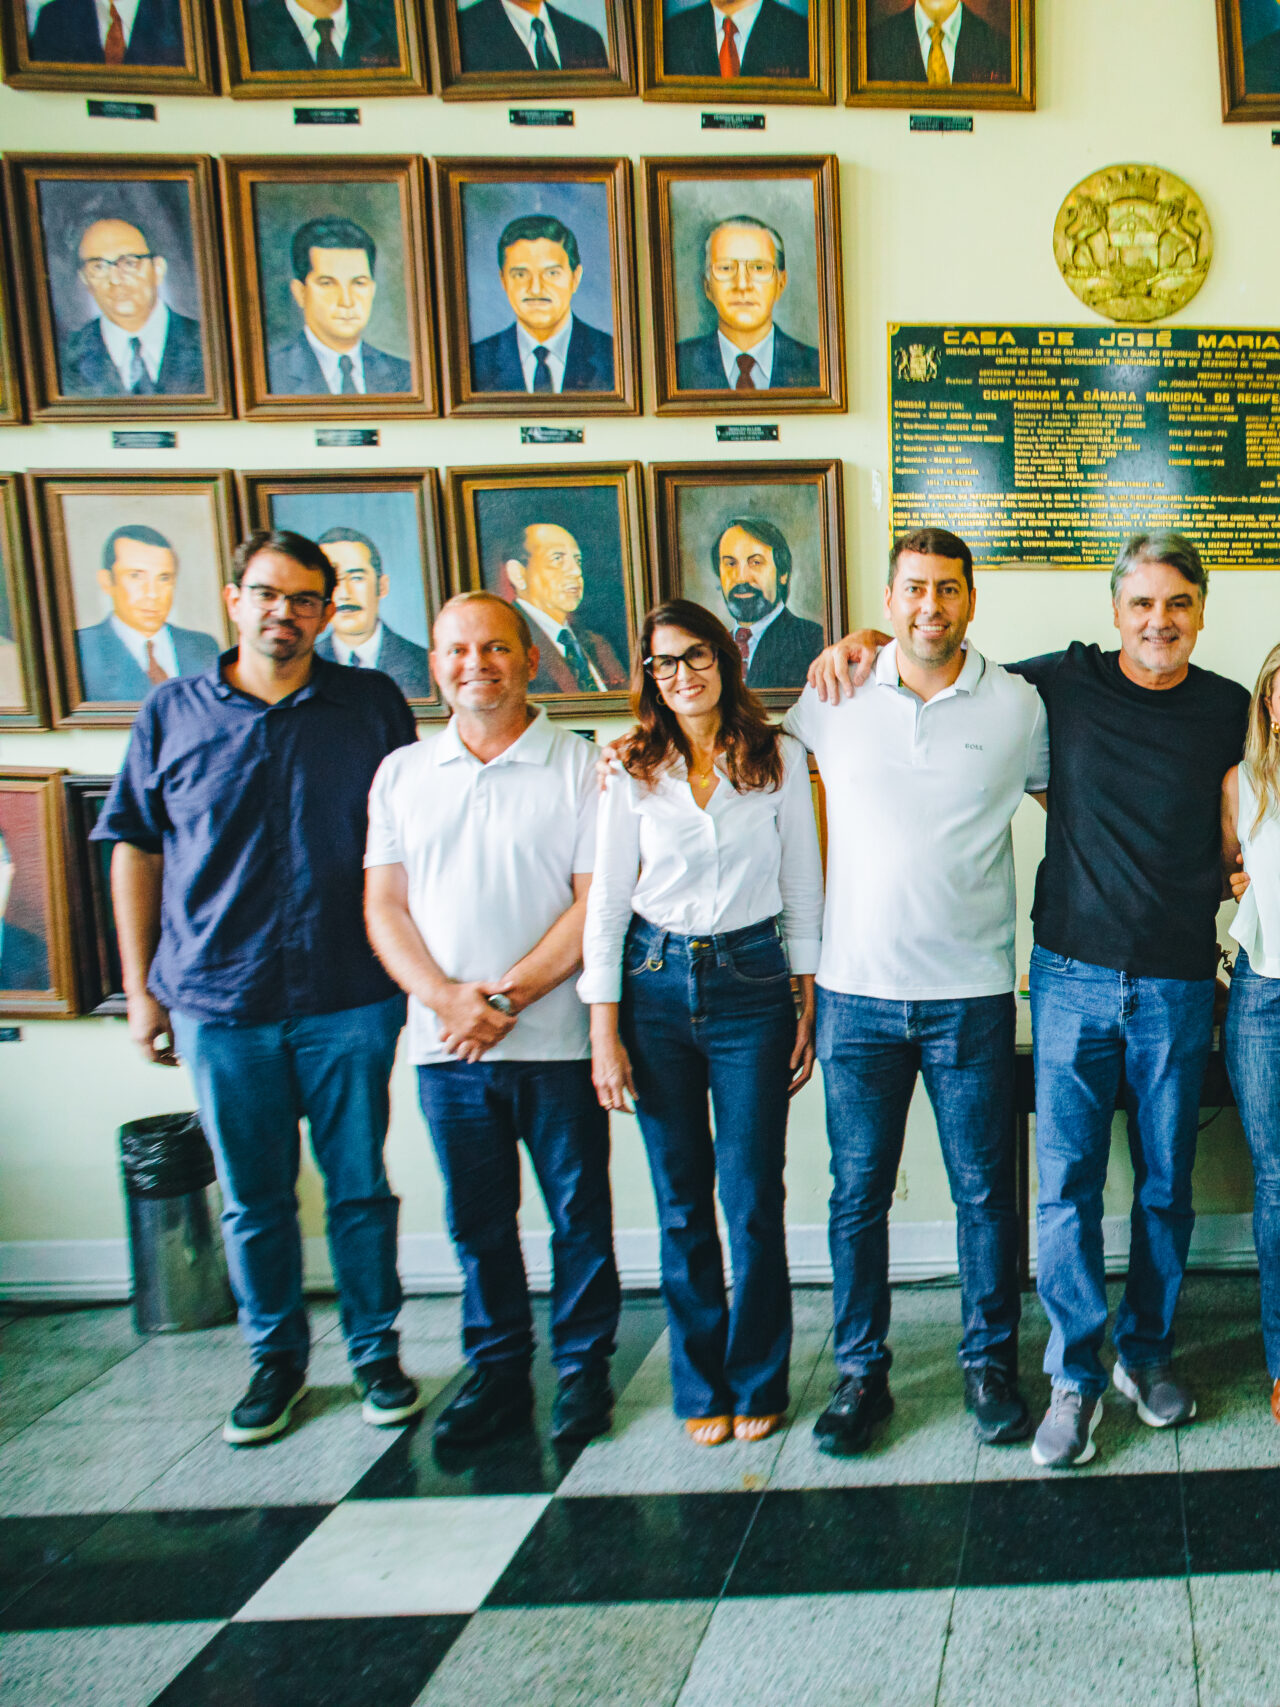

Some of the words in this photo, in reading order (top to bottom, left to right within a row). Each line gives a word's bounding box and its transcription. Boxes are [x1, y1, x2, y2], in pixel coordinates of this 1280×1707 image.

[944, 332, 1015, 345] CASA
[1038, 332, 1074, 345] DE
[1100, 330, 1172, 345] JOSÉ
[946, 348, 980, 356] INSTALADA
[983, 348, 1003, 356] NESTE
[1006, 348, 1028, 356] PRÉDIO
[1031, 349, 1041, 357] EM
[1053, 349, 1062, 357] DE
[1064, 349, 1093, 357] OUTUBRO
[1149, 350, 1160, 358] FOI
[996, 357, 1017, 365] OBRAS
[1031, 358, 1062, 366] REFORMA
[1065, 358, 1110, 366] OFICIALMENTE
[1114, 358, 1161, 366] INAUGURADAS
[1164, 359, 1175, 367] EM
[1189, 360, 1198, 368] DE
[1202, 360, 1238, 368] DEZEMBRO
[979, 378, 1010, 386] ROBERTO
[1170, 380, 1197, 388] JOAQUIM
[1199, 381, 1235, 389] FRANCISCO
[983, 391, 1060, 401] COMPUNHAM
[1066, 391, 1075, 401] A
[1084, 390, 1137, 402] CÂMARA
[1146, 393, 1206, 403] MUNICIPAL
[1214, 393, 1230, 403] DO
